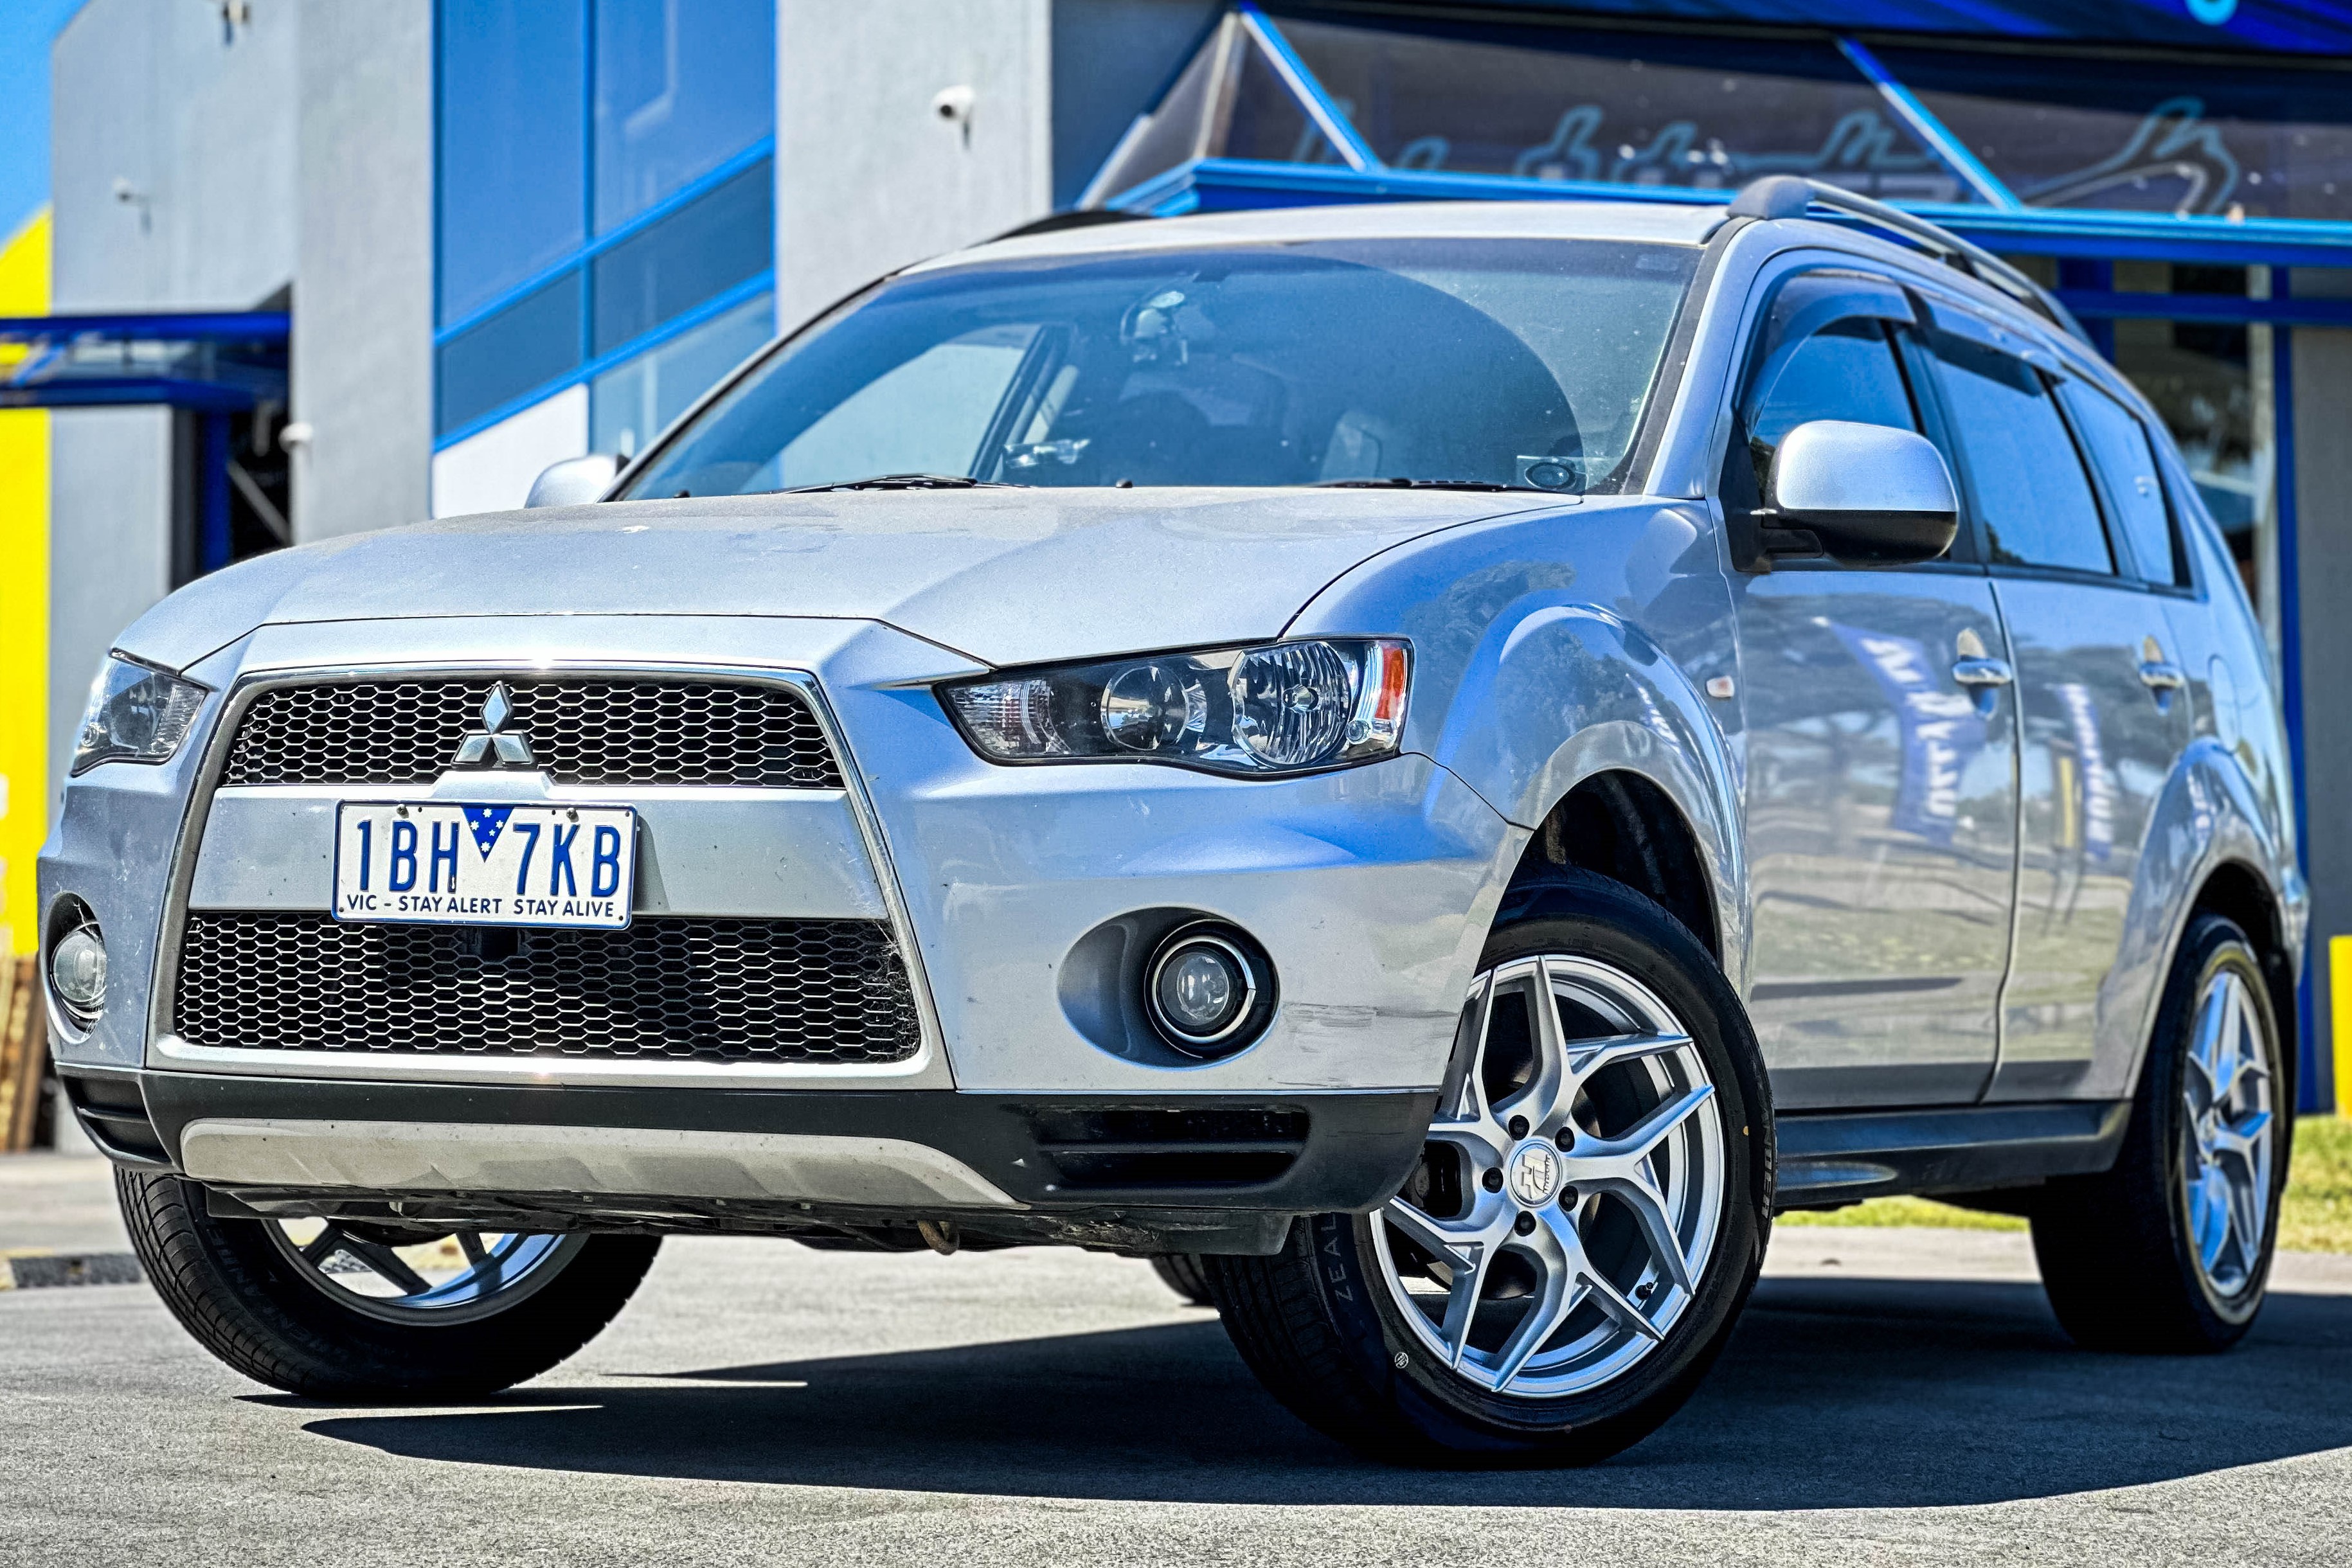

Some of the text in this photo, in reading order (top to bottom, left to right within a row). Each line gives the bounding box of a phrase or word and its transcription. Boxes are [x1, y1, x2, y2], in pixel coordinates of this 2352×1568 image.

[357, 819, 622, 898] 1BH 7KB
[346, 894, 377, 911] VIC
[398, 895, 442, 913] STAY
[446, 896, 503, 914] ALERT
[513, 898, 558, 916] STAY
[562, 900, 615, 918] ALIVE
[1320, 1212, 1353, 1302] ZEAL
